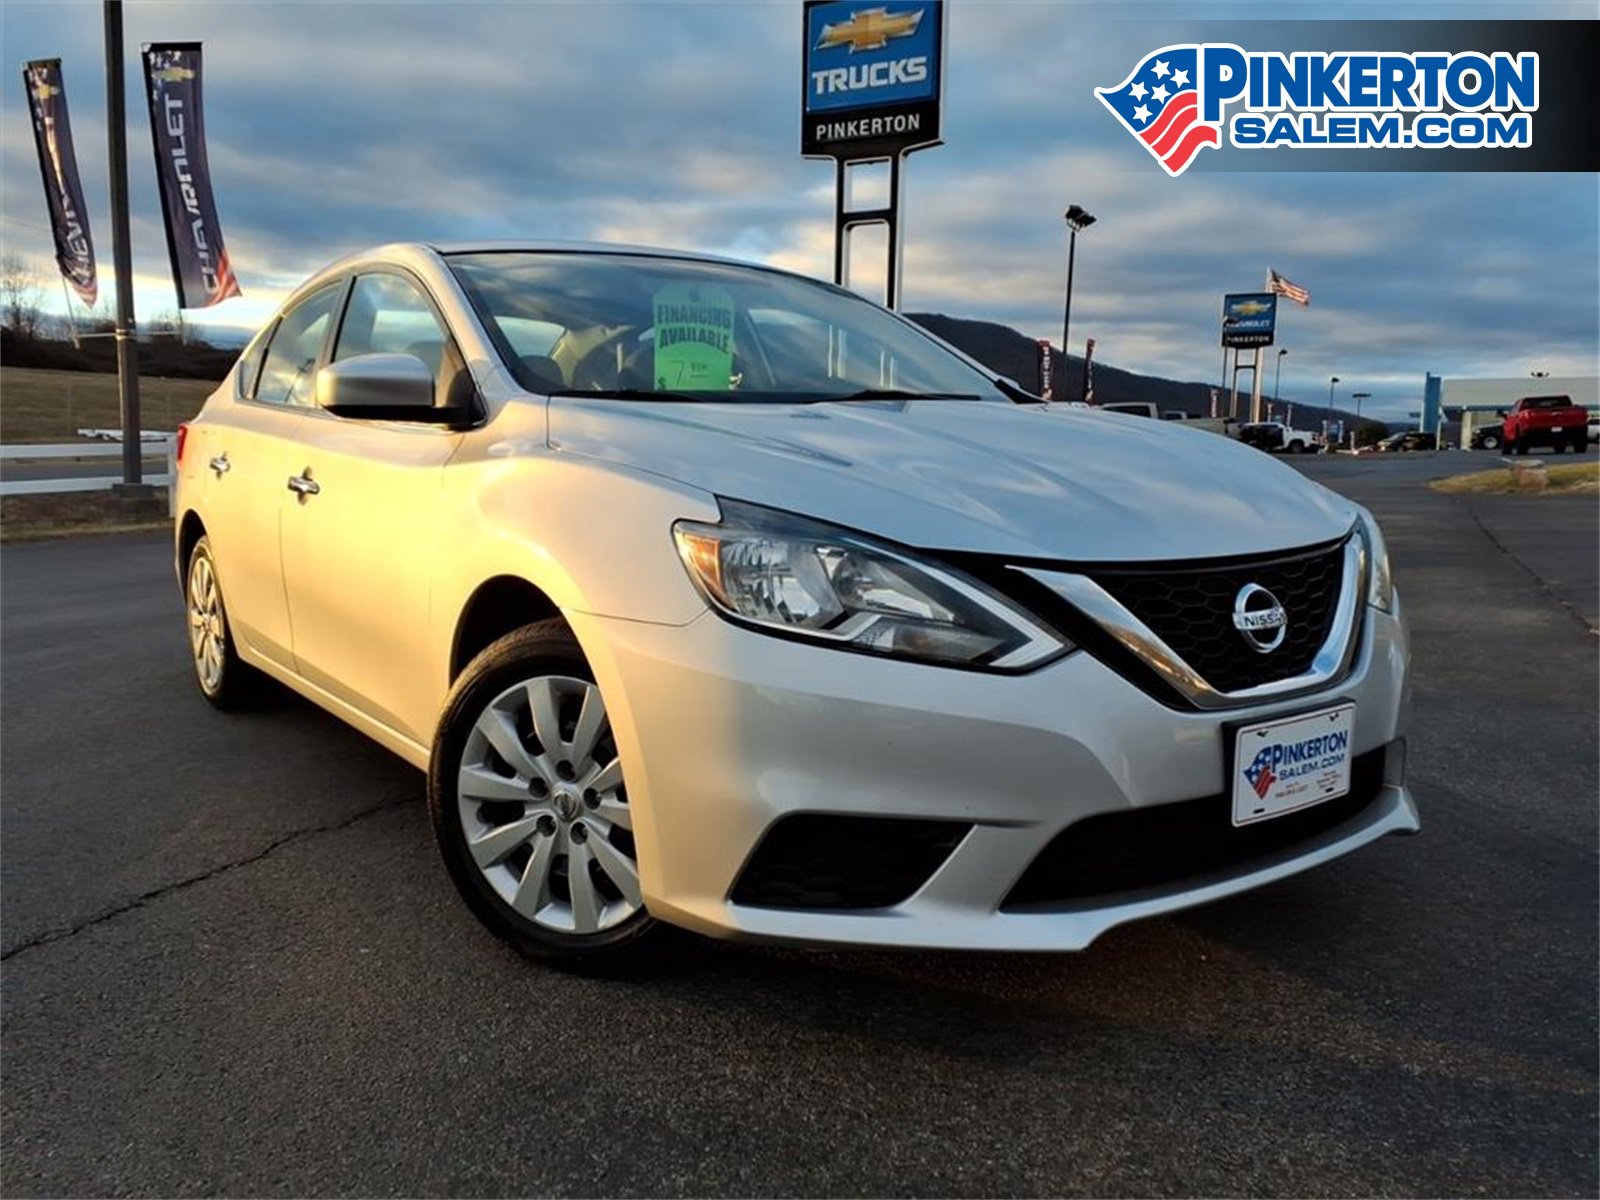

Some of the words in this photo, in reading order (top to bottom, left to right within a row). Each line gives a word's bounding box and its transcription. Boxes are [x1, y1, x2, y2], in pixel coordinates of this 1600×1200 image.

[812, 56, 927, 95] TRUCKS
[816, 113, 920, 140] PINKERTON
[657, 303, 731, 329] FINANCING
[659, 326, 730, 355] AVAILABLE
[1272, 730, 1348, 773] PINKERTON
[1280, 753, 1345, 781] SALEM.COM
